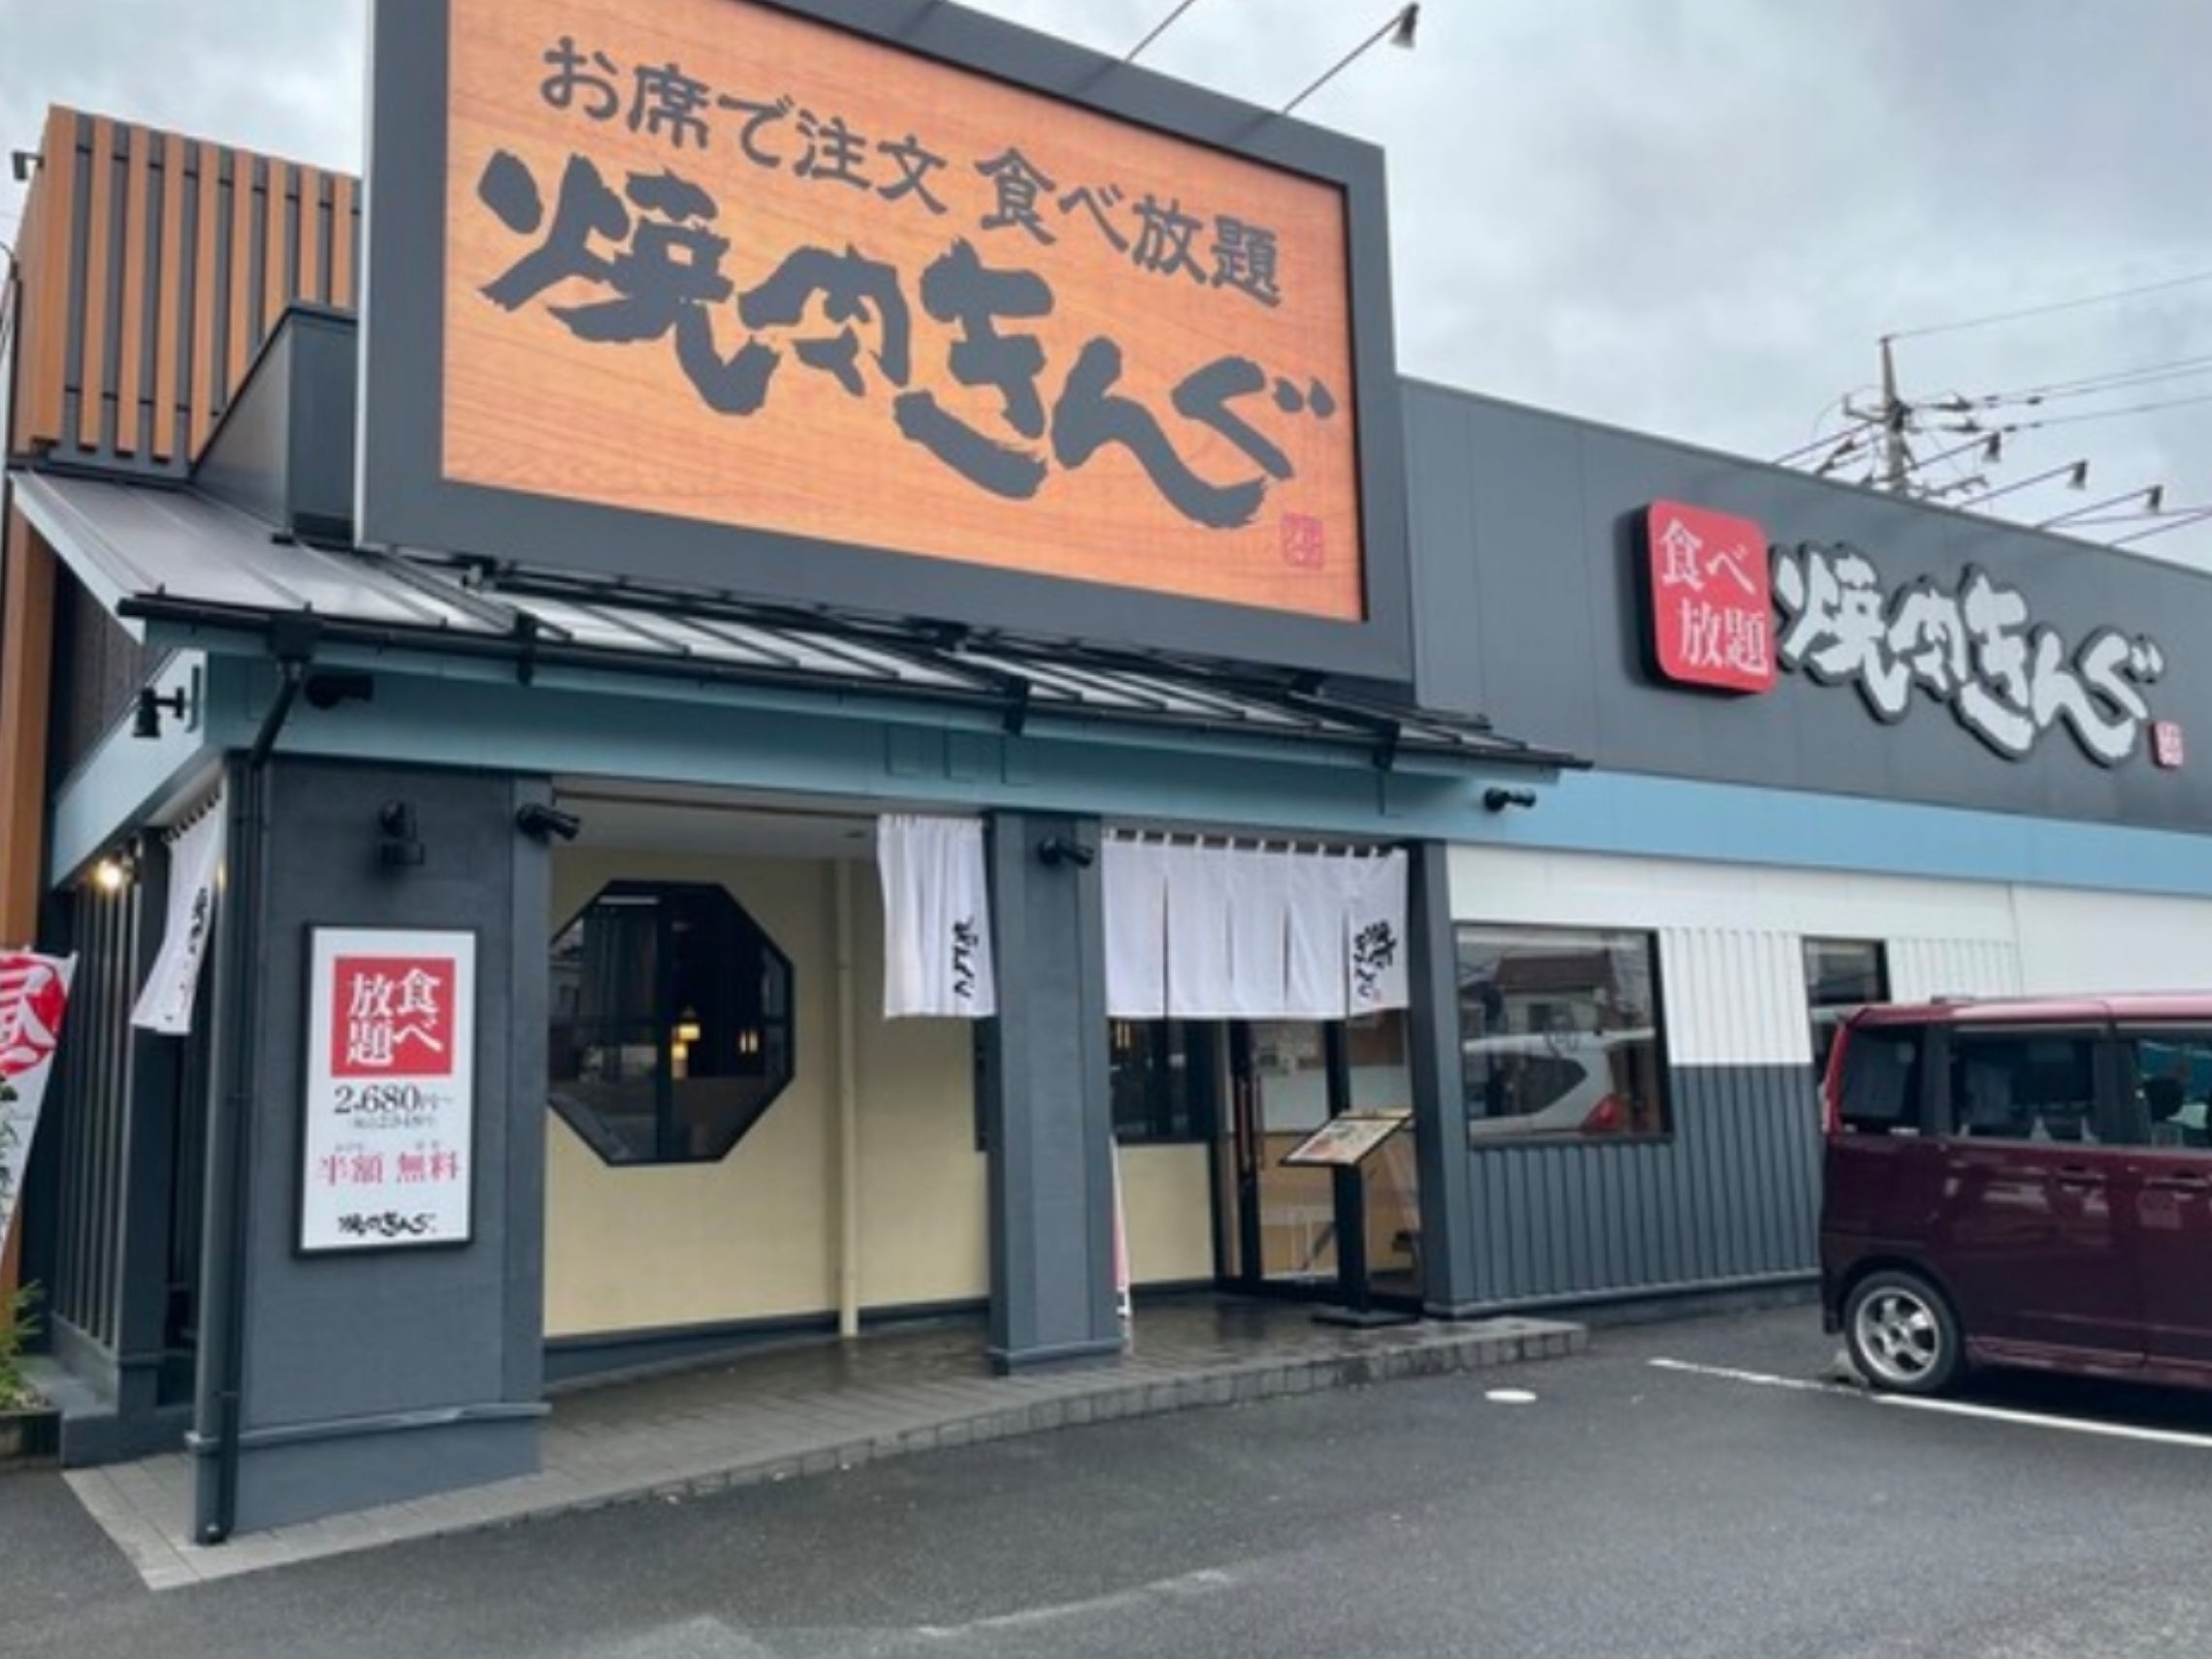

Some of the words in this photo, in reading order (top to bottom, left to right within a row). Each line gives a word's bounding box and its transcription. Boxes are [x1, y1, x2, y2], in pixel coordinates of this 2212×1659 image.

[539, 36, 948, 214] お席で注文
[974, 147, 1282, 308] 食べ放題
[477, 149, 1336, 530] 焼肉きんぐ
[1659, 518, 1756, 595] 食べ
[1678, 598, 1769, 676] 放題
[1773, 545, 2164, 763] 焼肉きんぐ
[347, 971, 395, 1066] 放題
[394, 967, 442, 1053] 食べ
